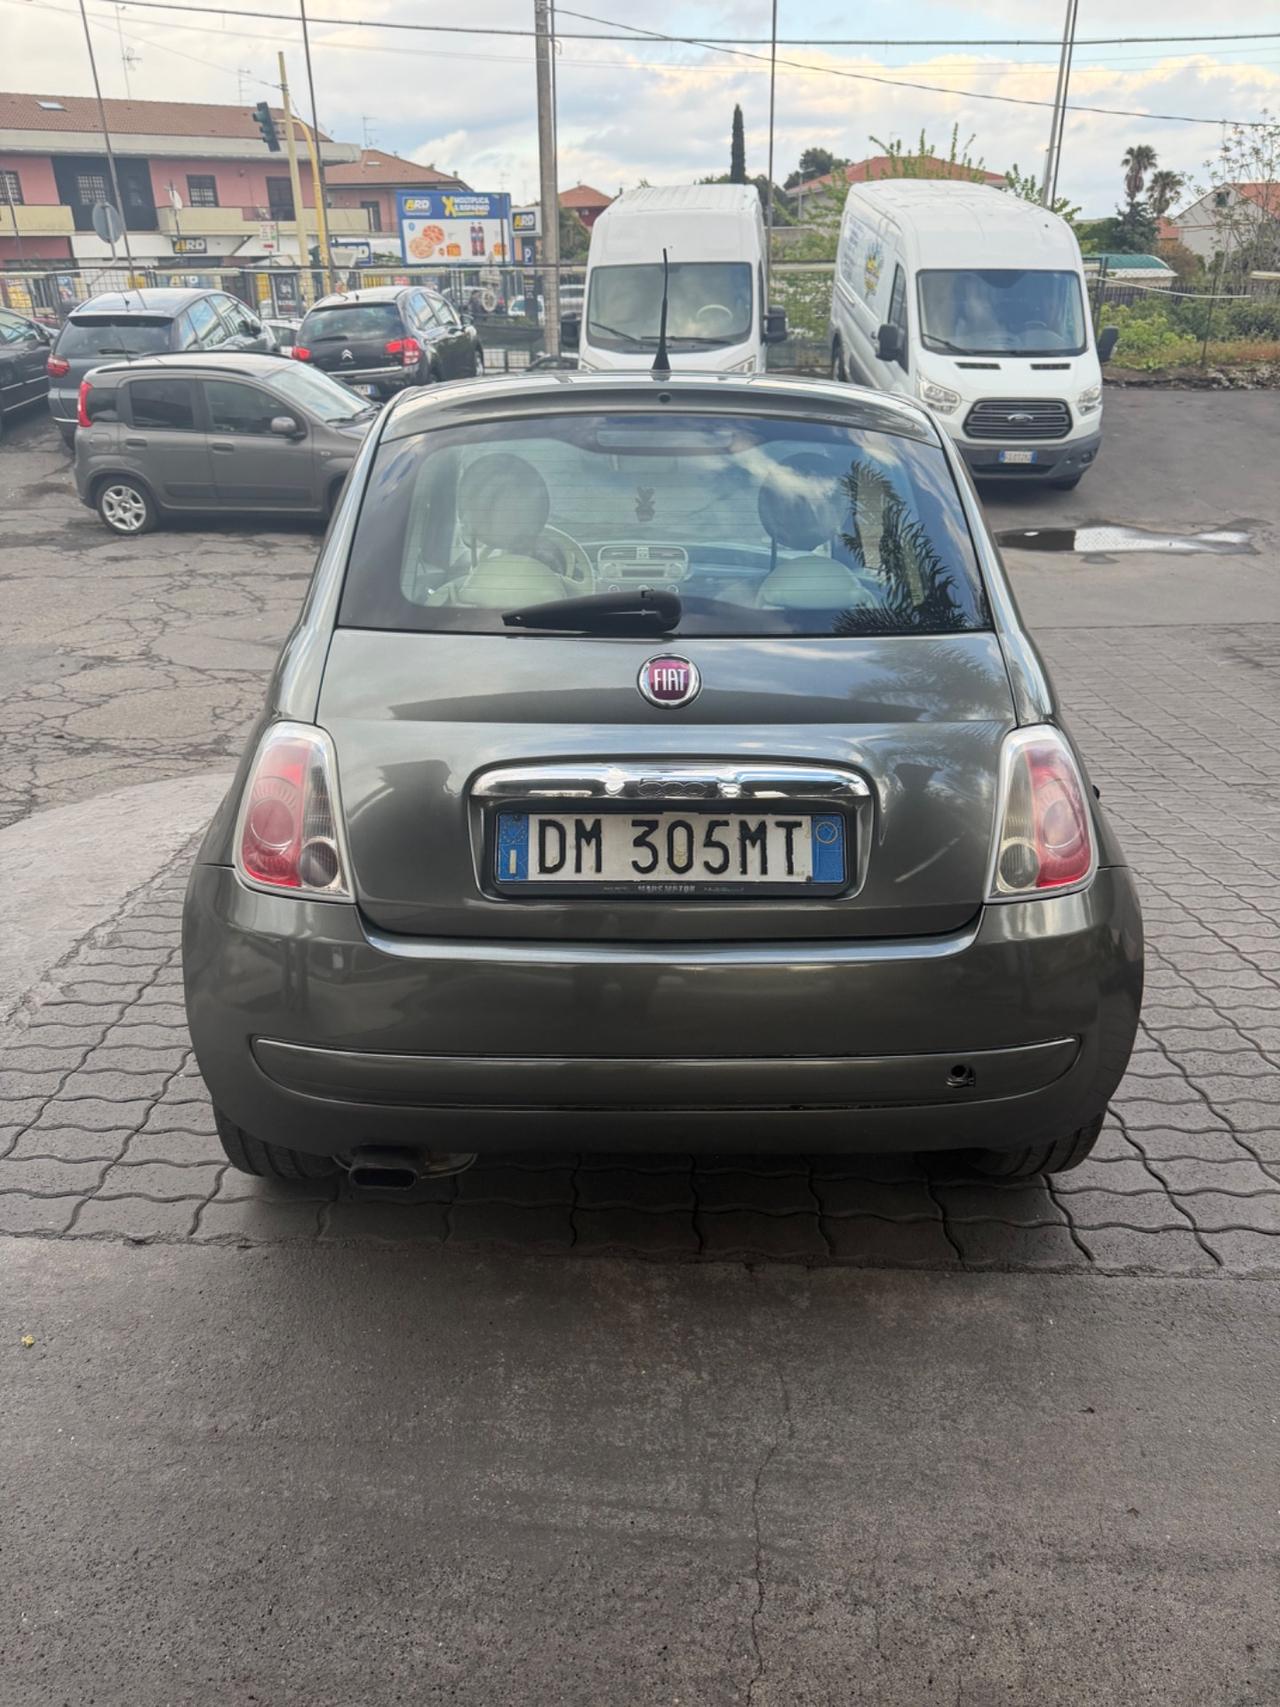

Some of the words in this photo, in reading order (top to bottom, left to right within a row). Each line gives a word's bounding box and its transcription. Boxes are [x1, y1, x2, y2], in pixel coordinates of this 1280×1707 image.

[405, 199, 430, 211] ARD
[514, 214, 534, 229] ARD
[175, 239, 205, 253] ARD
[524, 248, 532, 262] P
[654, 668, 688, 691] FIAT
[538, 818, 603, 874] DM
[631, 819, 803, 876] 305MT
